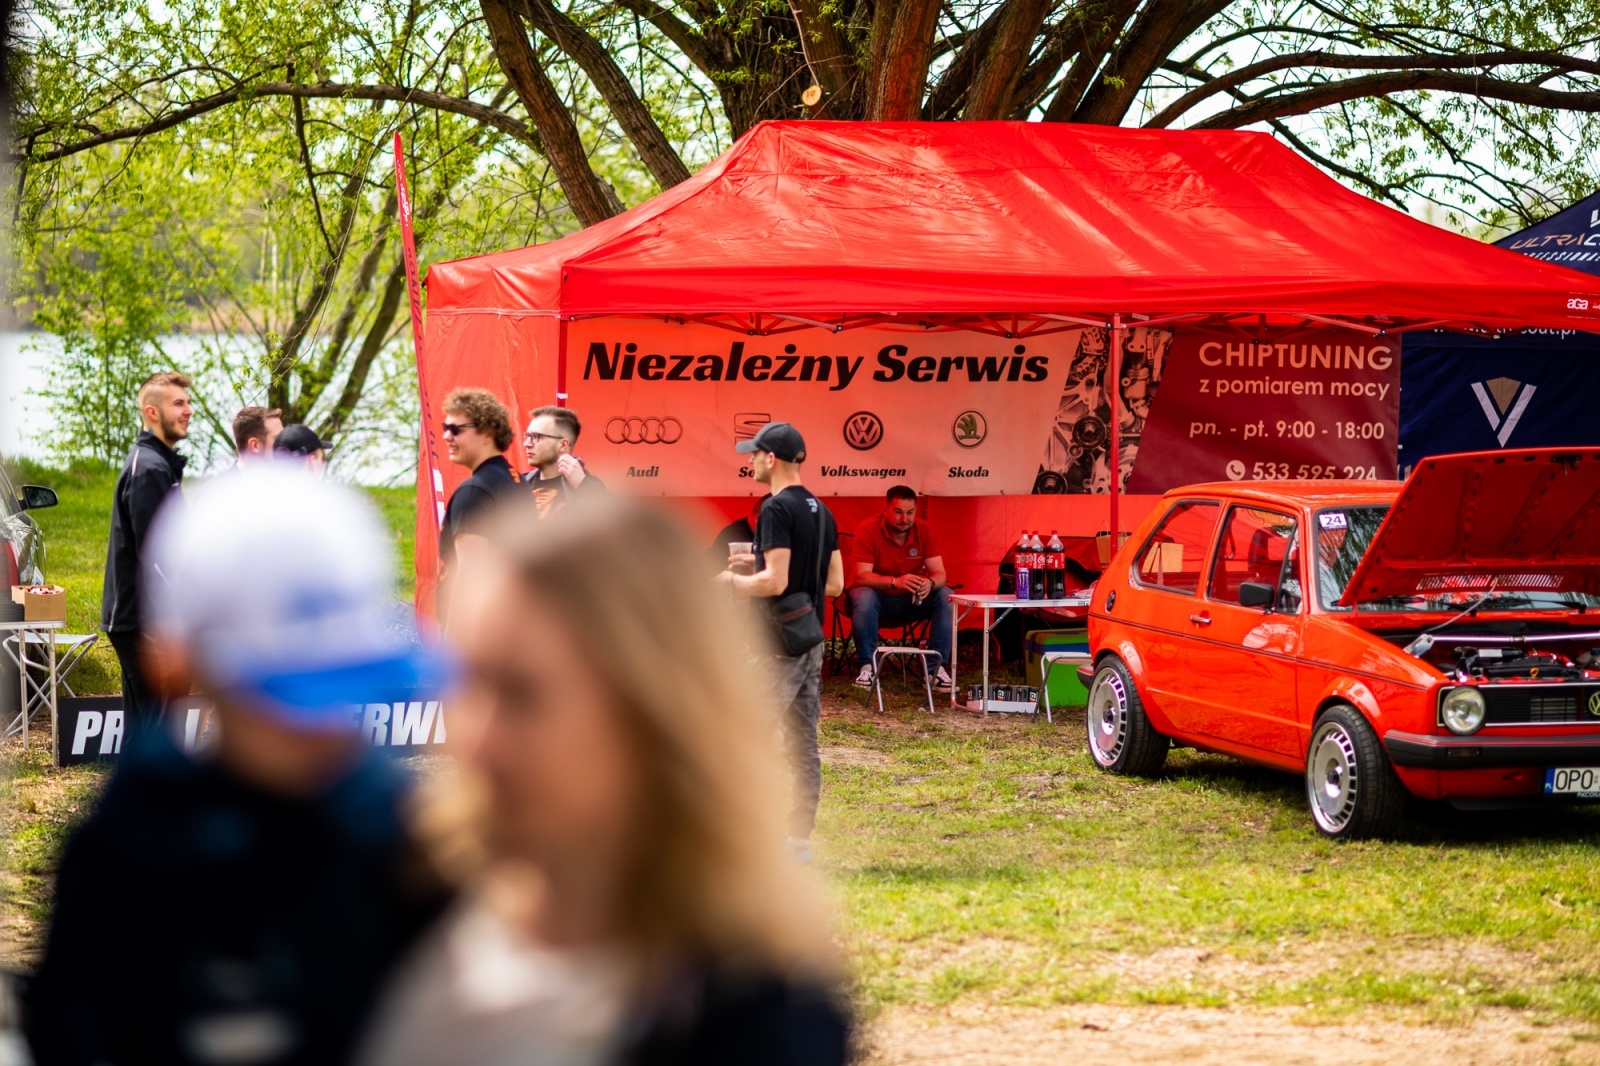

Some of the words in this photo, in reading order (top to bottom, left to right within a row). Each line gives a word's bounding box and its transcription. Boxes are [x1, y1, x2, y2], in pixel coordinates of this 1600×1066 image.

[1509, 233, 1600, 249] ULTRAC
[1199, 342, 1393, 370] CHIPTUNING
[583, 342, 865, 391] Niezależny
[873, 344, 1049, 383] Serwis
[1199, 378, 1210, 393] z
[1216, 375, 1324, 397] pomiarem
[1331, 381, 1390, 401] mocy
[1189, 422, 1221, 438] pn.
[1243, 420, 1269, 440] pt.
[1276, 420, 1315, 438] 9:00
[1335, 421, 1385, 440] 18:00
[627, 465, 659, 478] Audi
[738, 466, 754, 478] Se
[821, 465, 906, 479] Volkswagen
[948, 465, 989, 478] Skoda
[1252, 462, 1289, 480] 533
[1296, 465, 1336, 480] 595
[1324, 516, 1342, 525] 24
[1555, 769, 1594, 790] OPO
